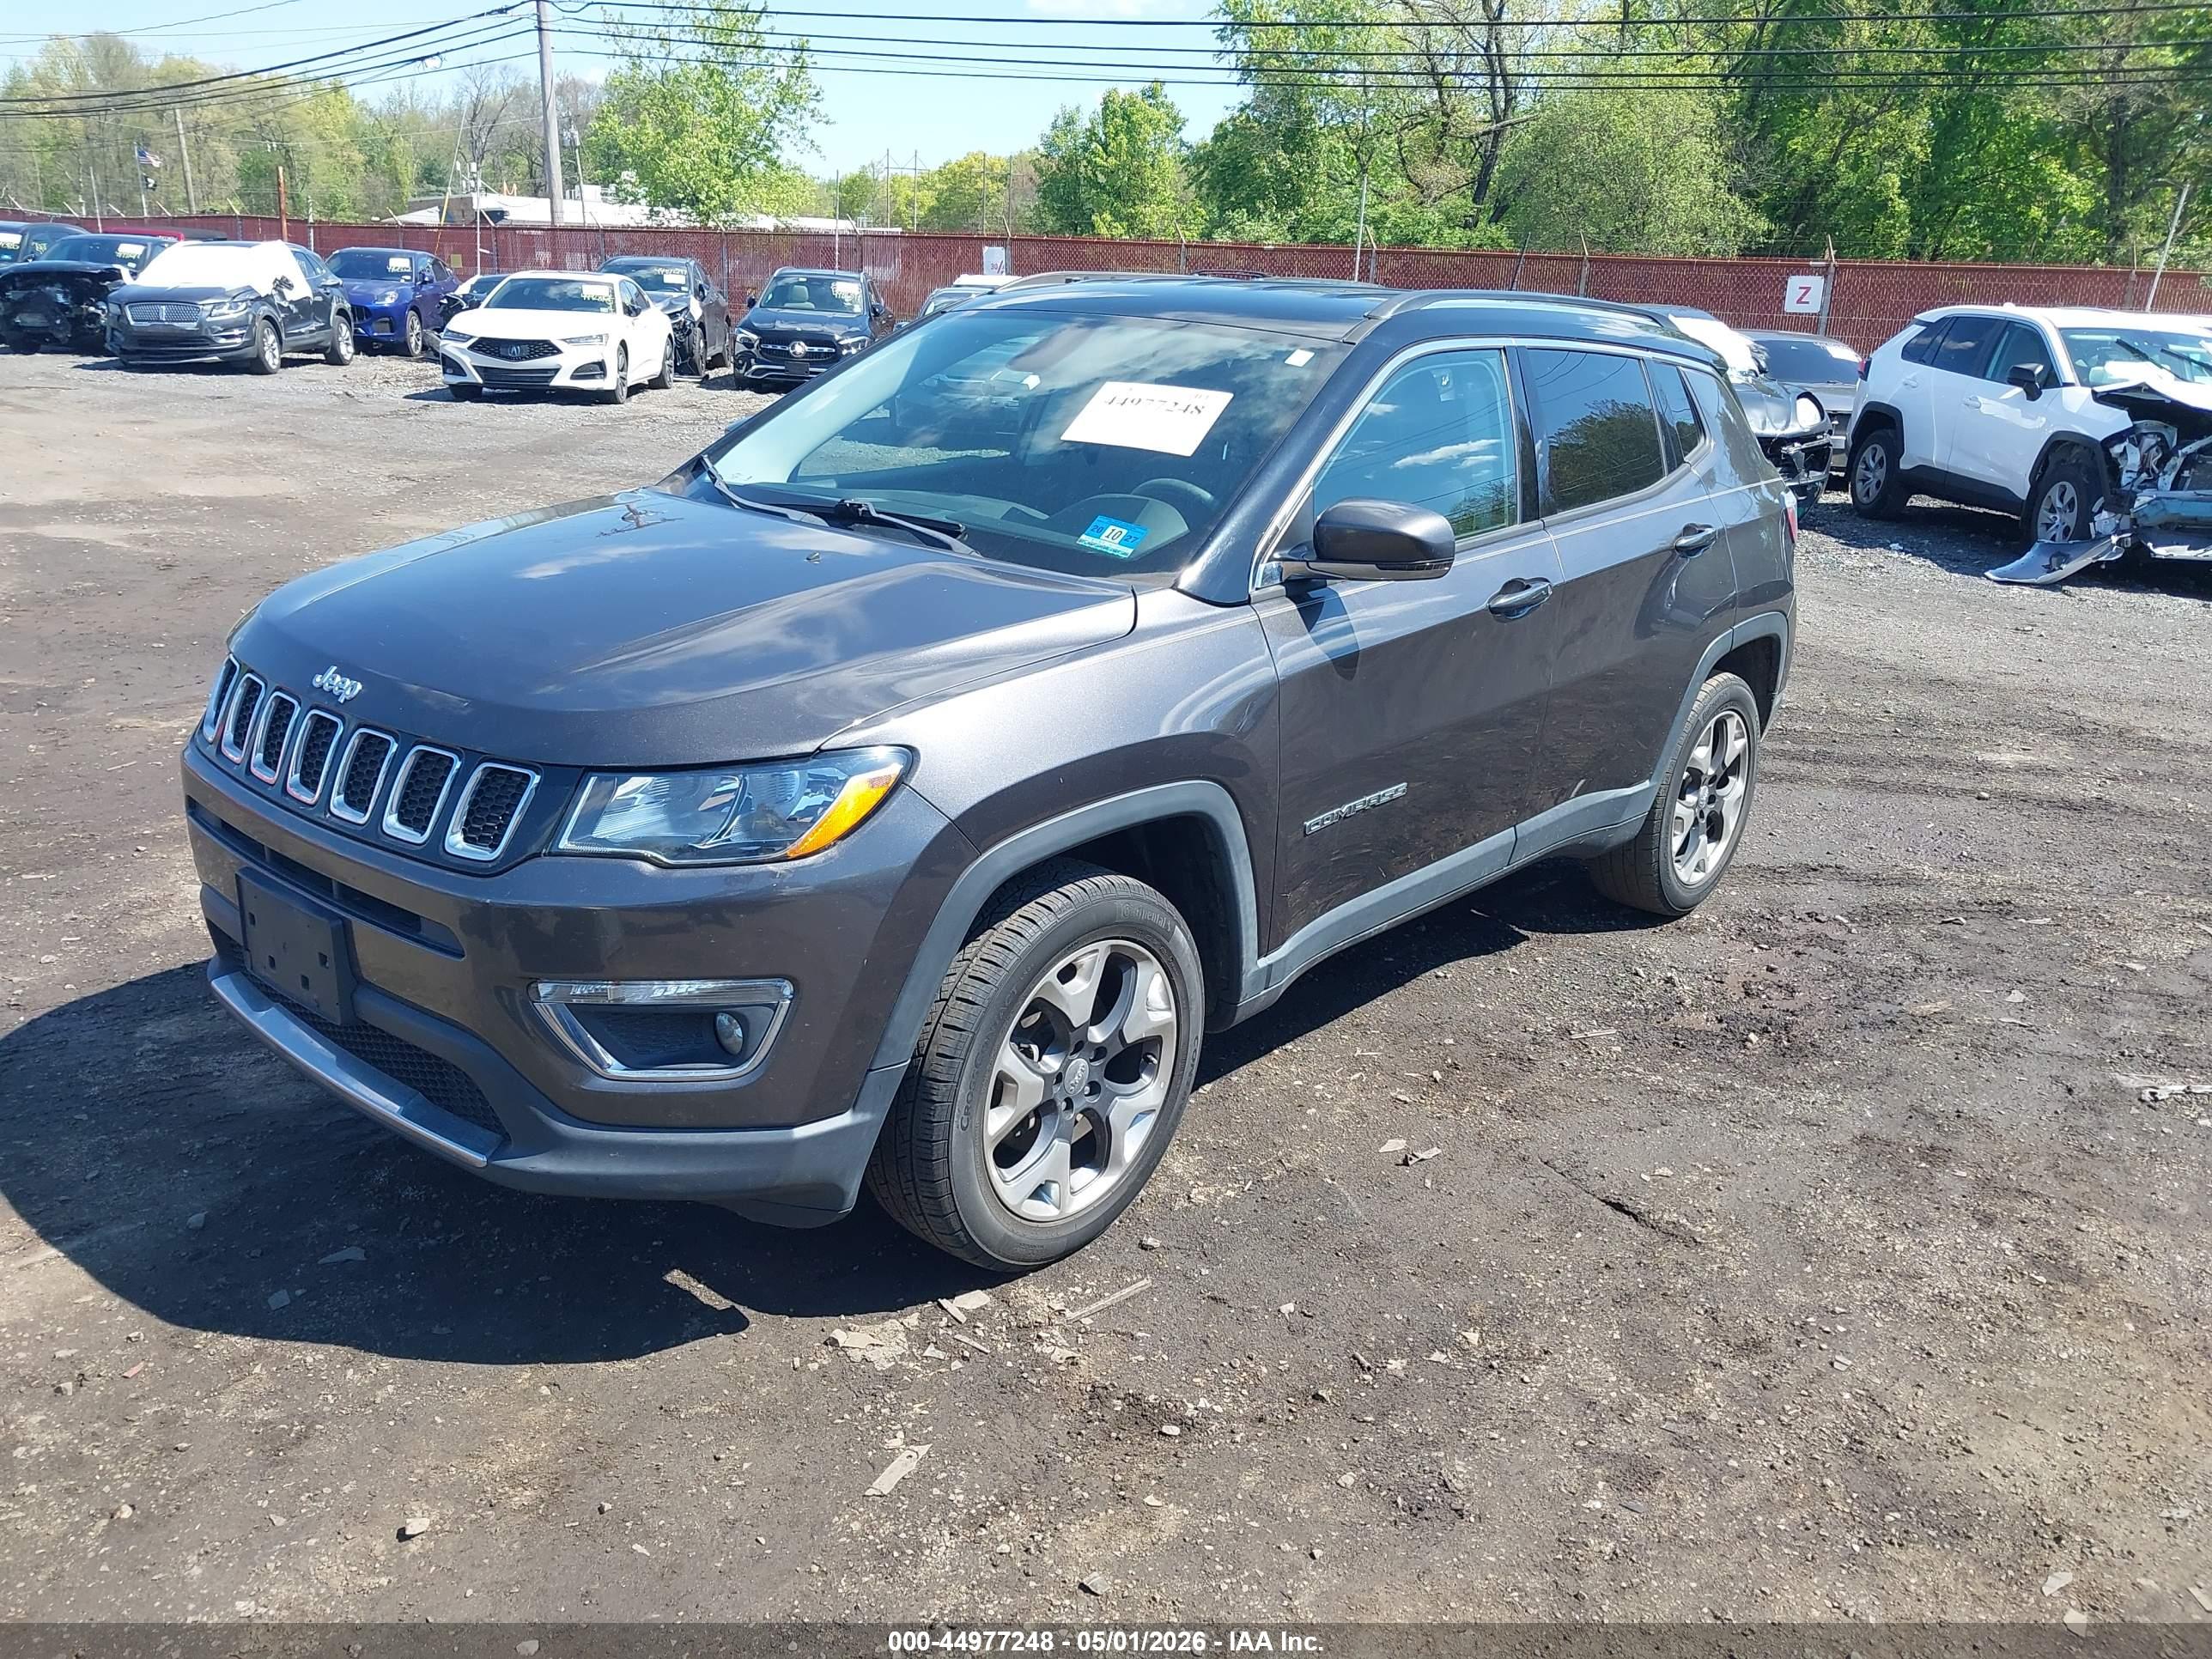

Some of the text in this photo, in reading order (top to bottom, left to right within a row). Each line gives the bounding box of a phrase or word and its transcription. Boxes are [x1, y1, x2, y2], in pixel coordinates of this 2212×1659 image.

[1796, 286, 1812, 305] Z
[1091, 525, 1139, 544] 20 10 27
[312, 665, 362, 703] Jeep
[1304, 782, 1408, 835] COMPASS
